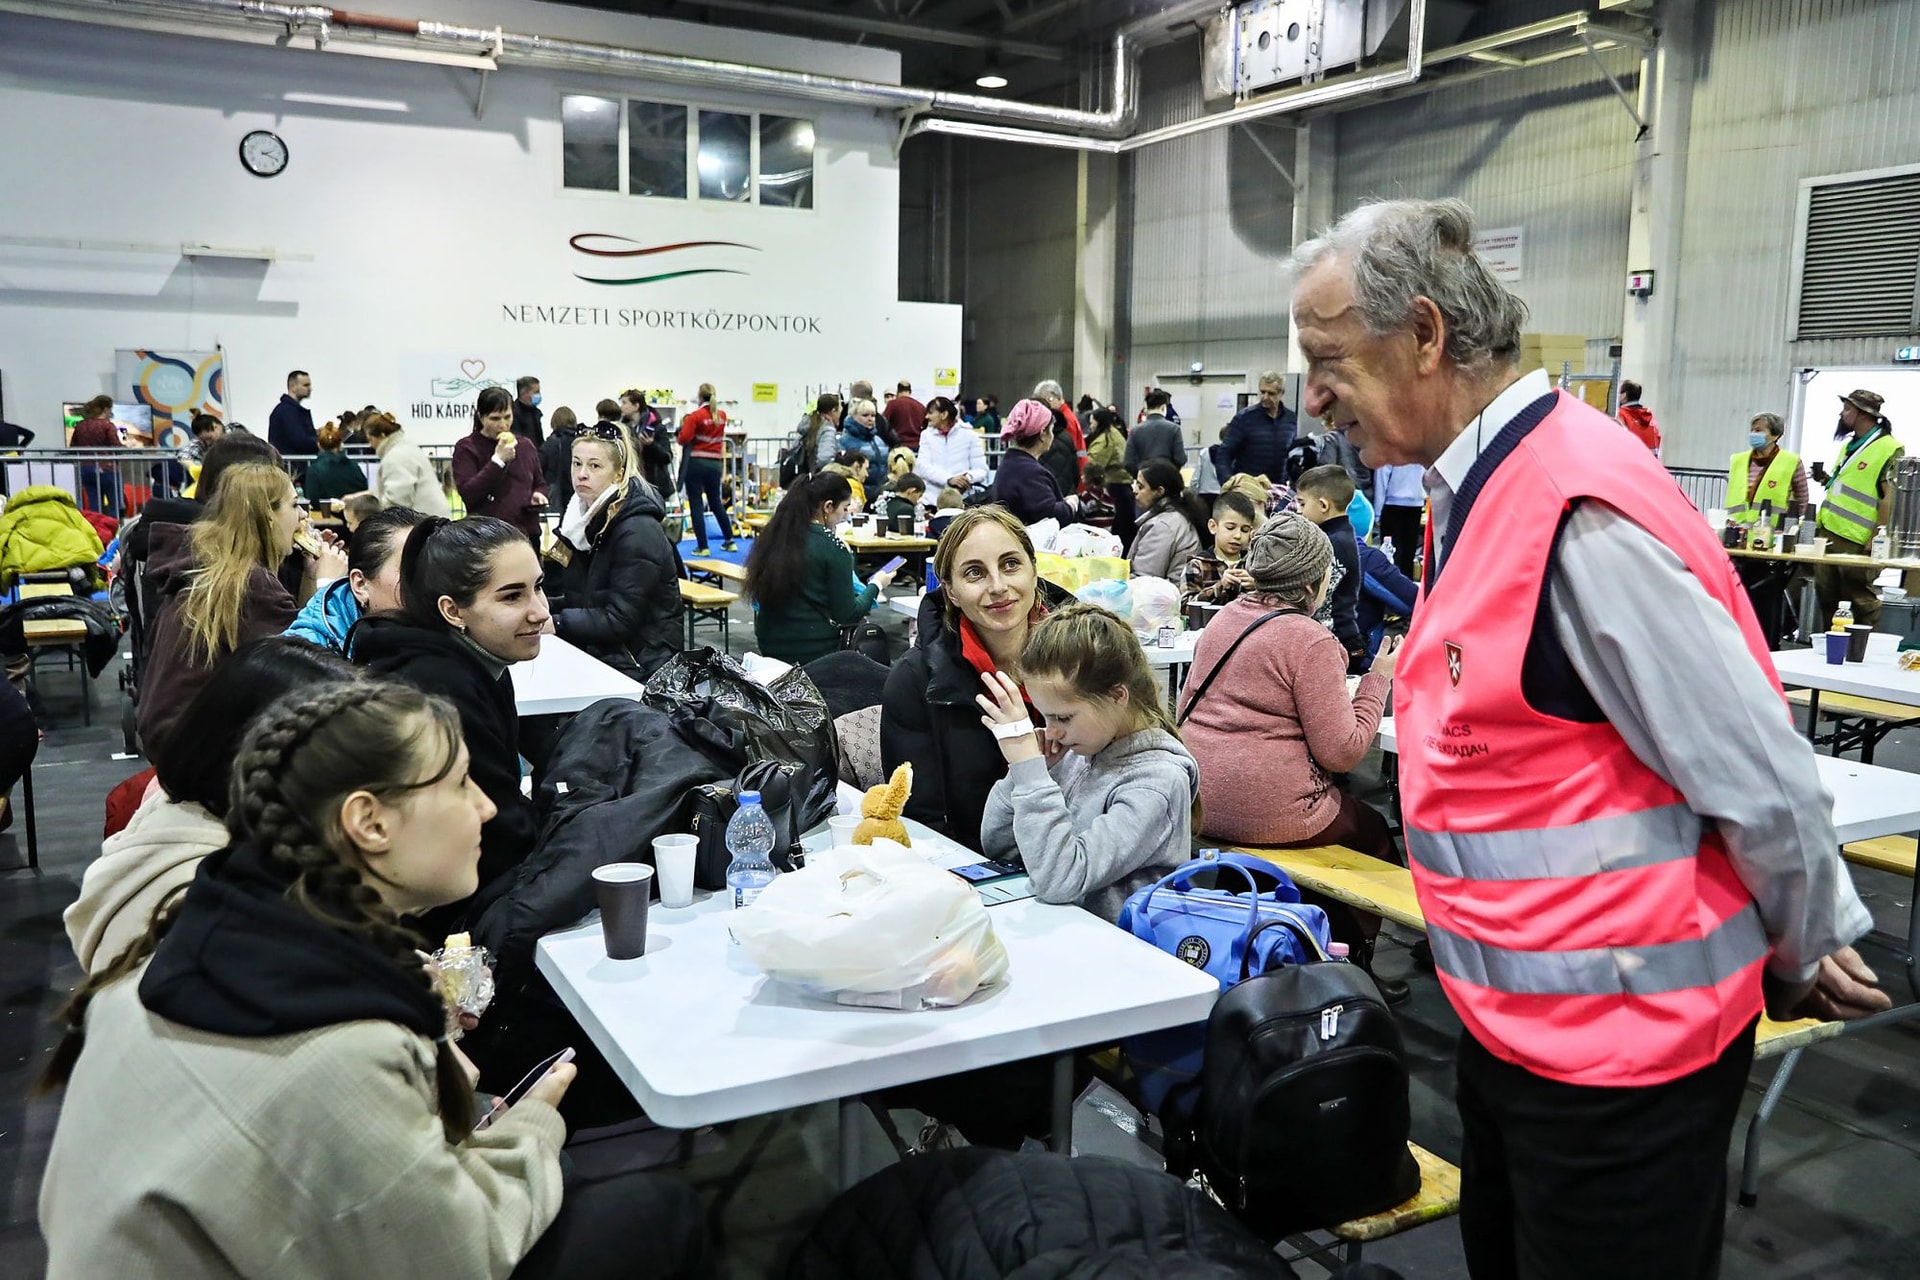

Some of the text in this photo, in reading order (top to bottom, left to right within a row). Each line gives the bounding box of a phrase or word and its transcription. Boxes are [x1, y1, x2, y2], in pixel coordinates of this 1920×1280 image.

[502, 304, 822, 334] NEMZETI SPORTKÖZPONTOK
[411, 401, 432, 419] HÍD
